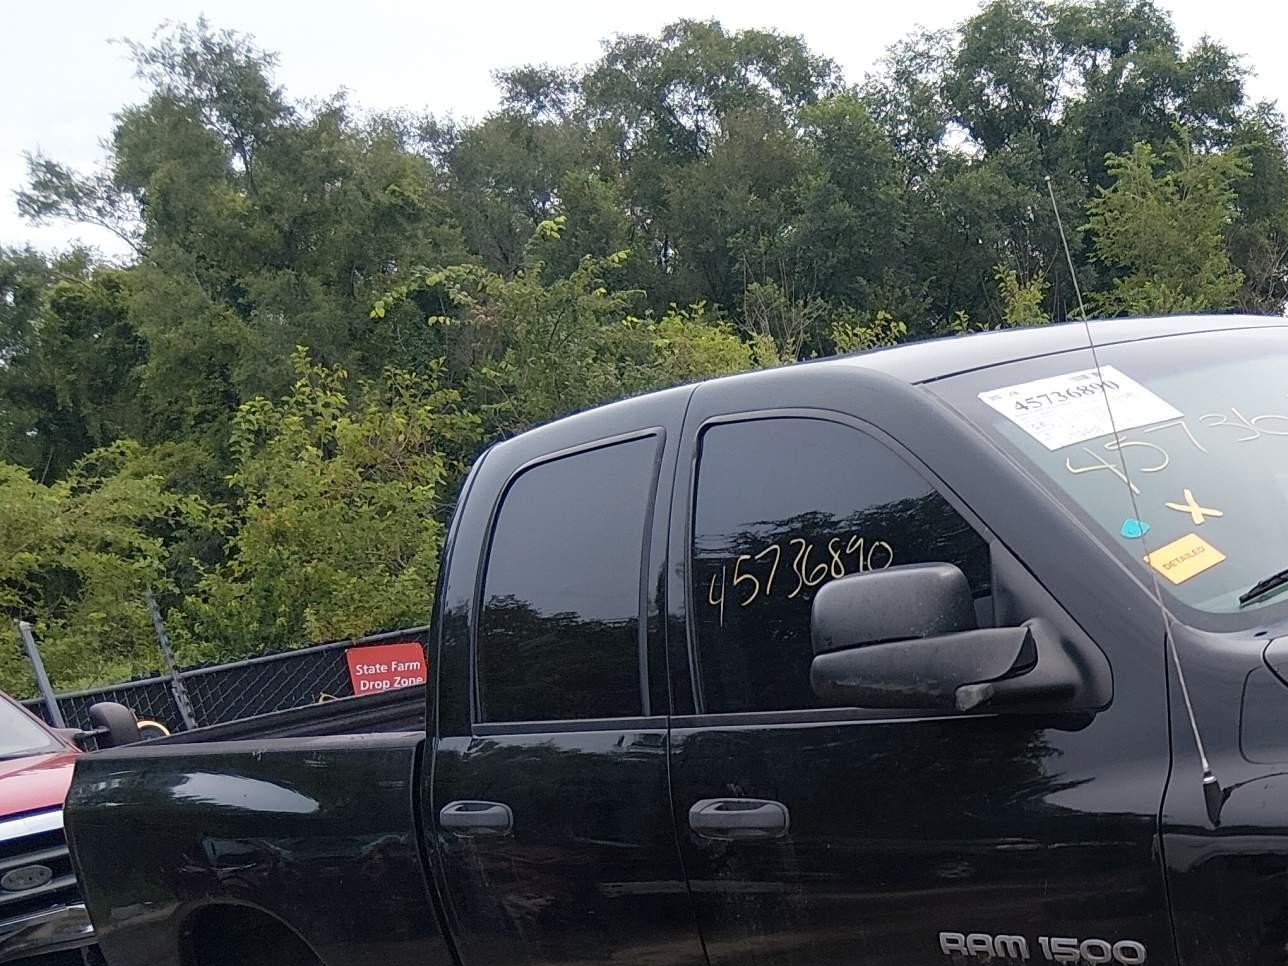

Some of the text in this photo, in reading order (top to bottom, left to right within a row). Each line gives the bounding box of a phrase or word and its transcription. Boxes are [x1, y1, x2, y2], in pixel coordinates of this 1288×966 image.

[1014, 379, 1120, 412] 45736890
[1162, 546, 1206, 571] DETAILED
[708, 535, 894, 629] 45736890
[355, 661, 420, 675] State Farm
[360, 676, 424, 690] Drop Zone
[938, 931, 1147, 965] RAM 1500
